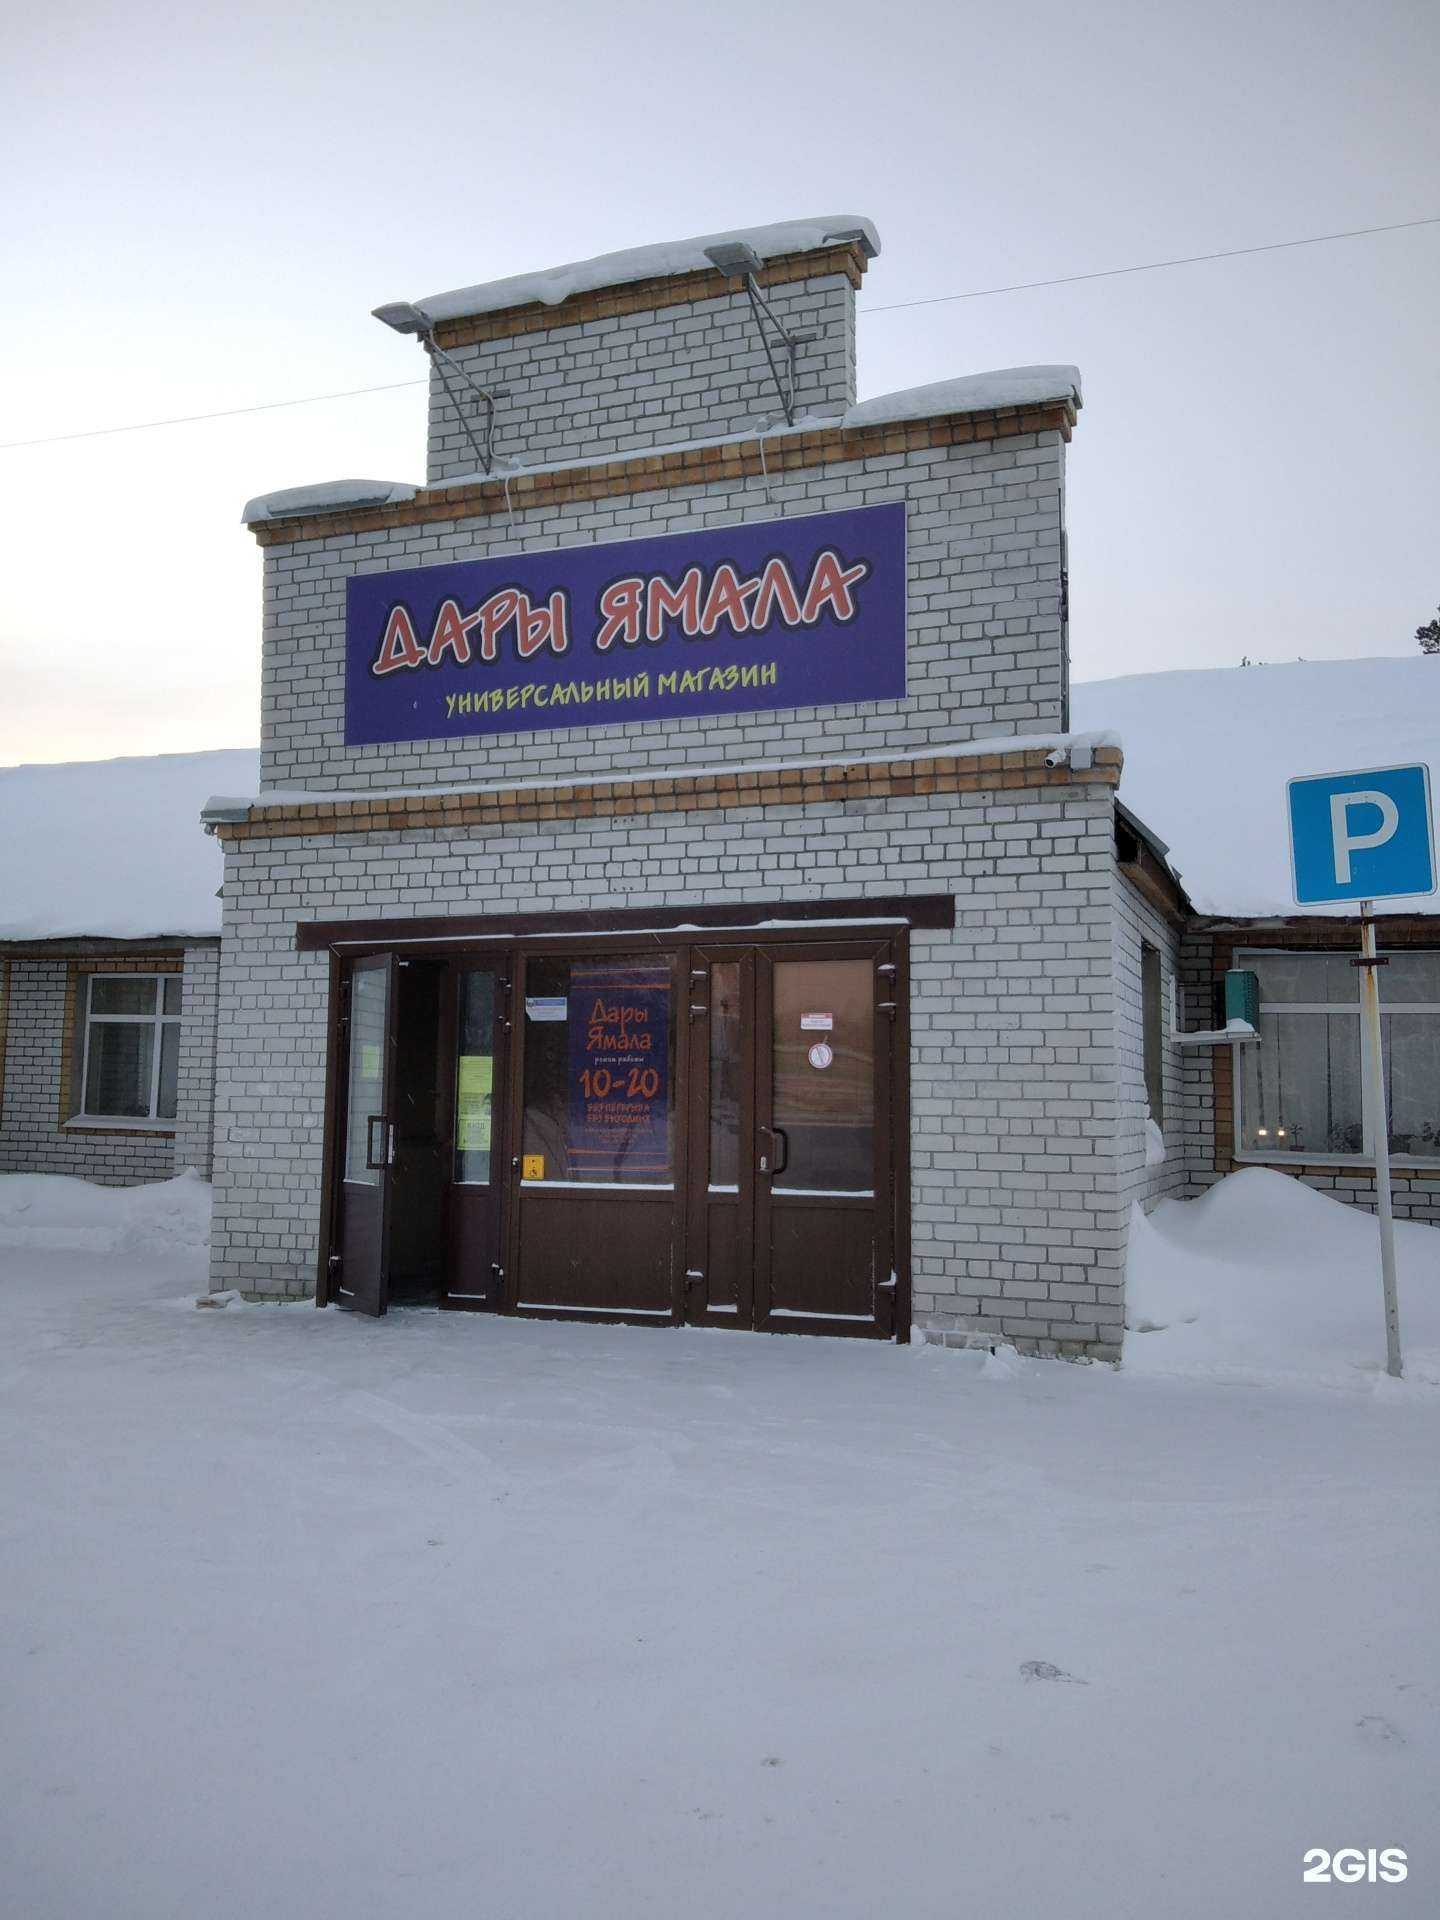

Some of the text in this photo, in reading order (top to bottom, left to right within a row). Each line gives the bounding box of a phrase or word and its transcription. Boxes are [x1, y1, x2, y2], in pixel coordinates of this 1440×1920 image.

[371, 551, 867, 675] ДАРЫ ЯМАЛА
[446, 661, 778, 718] УНИВЕРСАЛЬНЫЙ МАГАЗИН
[1329, 790, 1399, 884] P
[586, 1025, 653, 1051] Ямала
[588, 998, 648, 1035] Дары
[579, 1067, 660, 1099] 10-20
